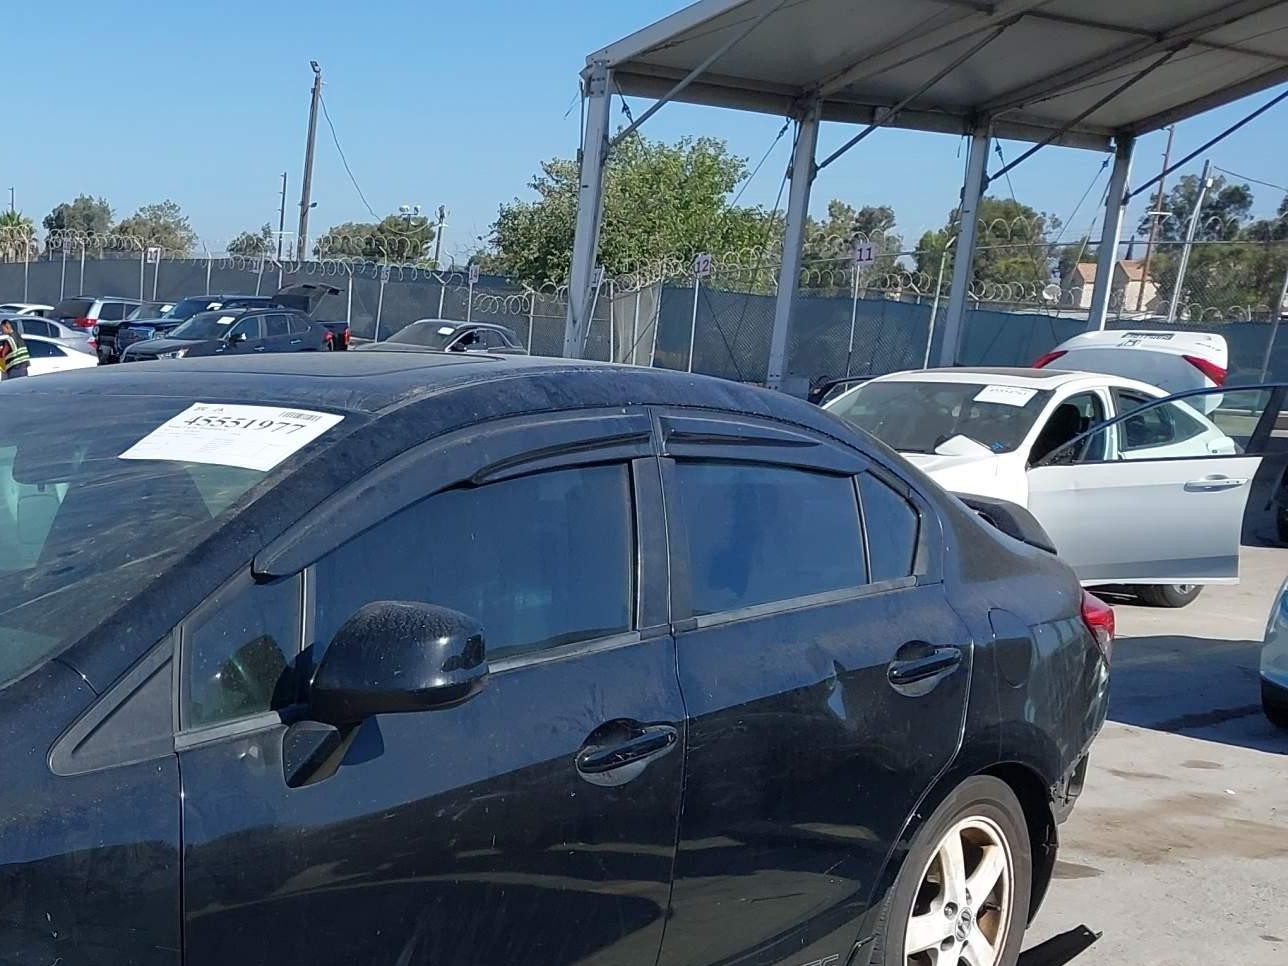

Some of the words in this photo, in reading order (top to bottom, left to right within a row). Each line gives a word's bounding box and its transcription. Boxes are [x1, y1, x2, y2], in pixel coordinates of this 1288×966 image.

[856, 247, 873, 261] 11
[695, 259, 710, 273] 12
[184, 415, 305, 435] 45551977
